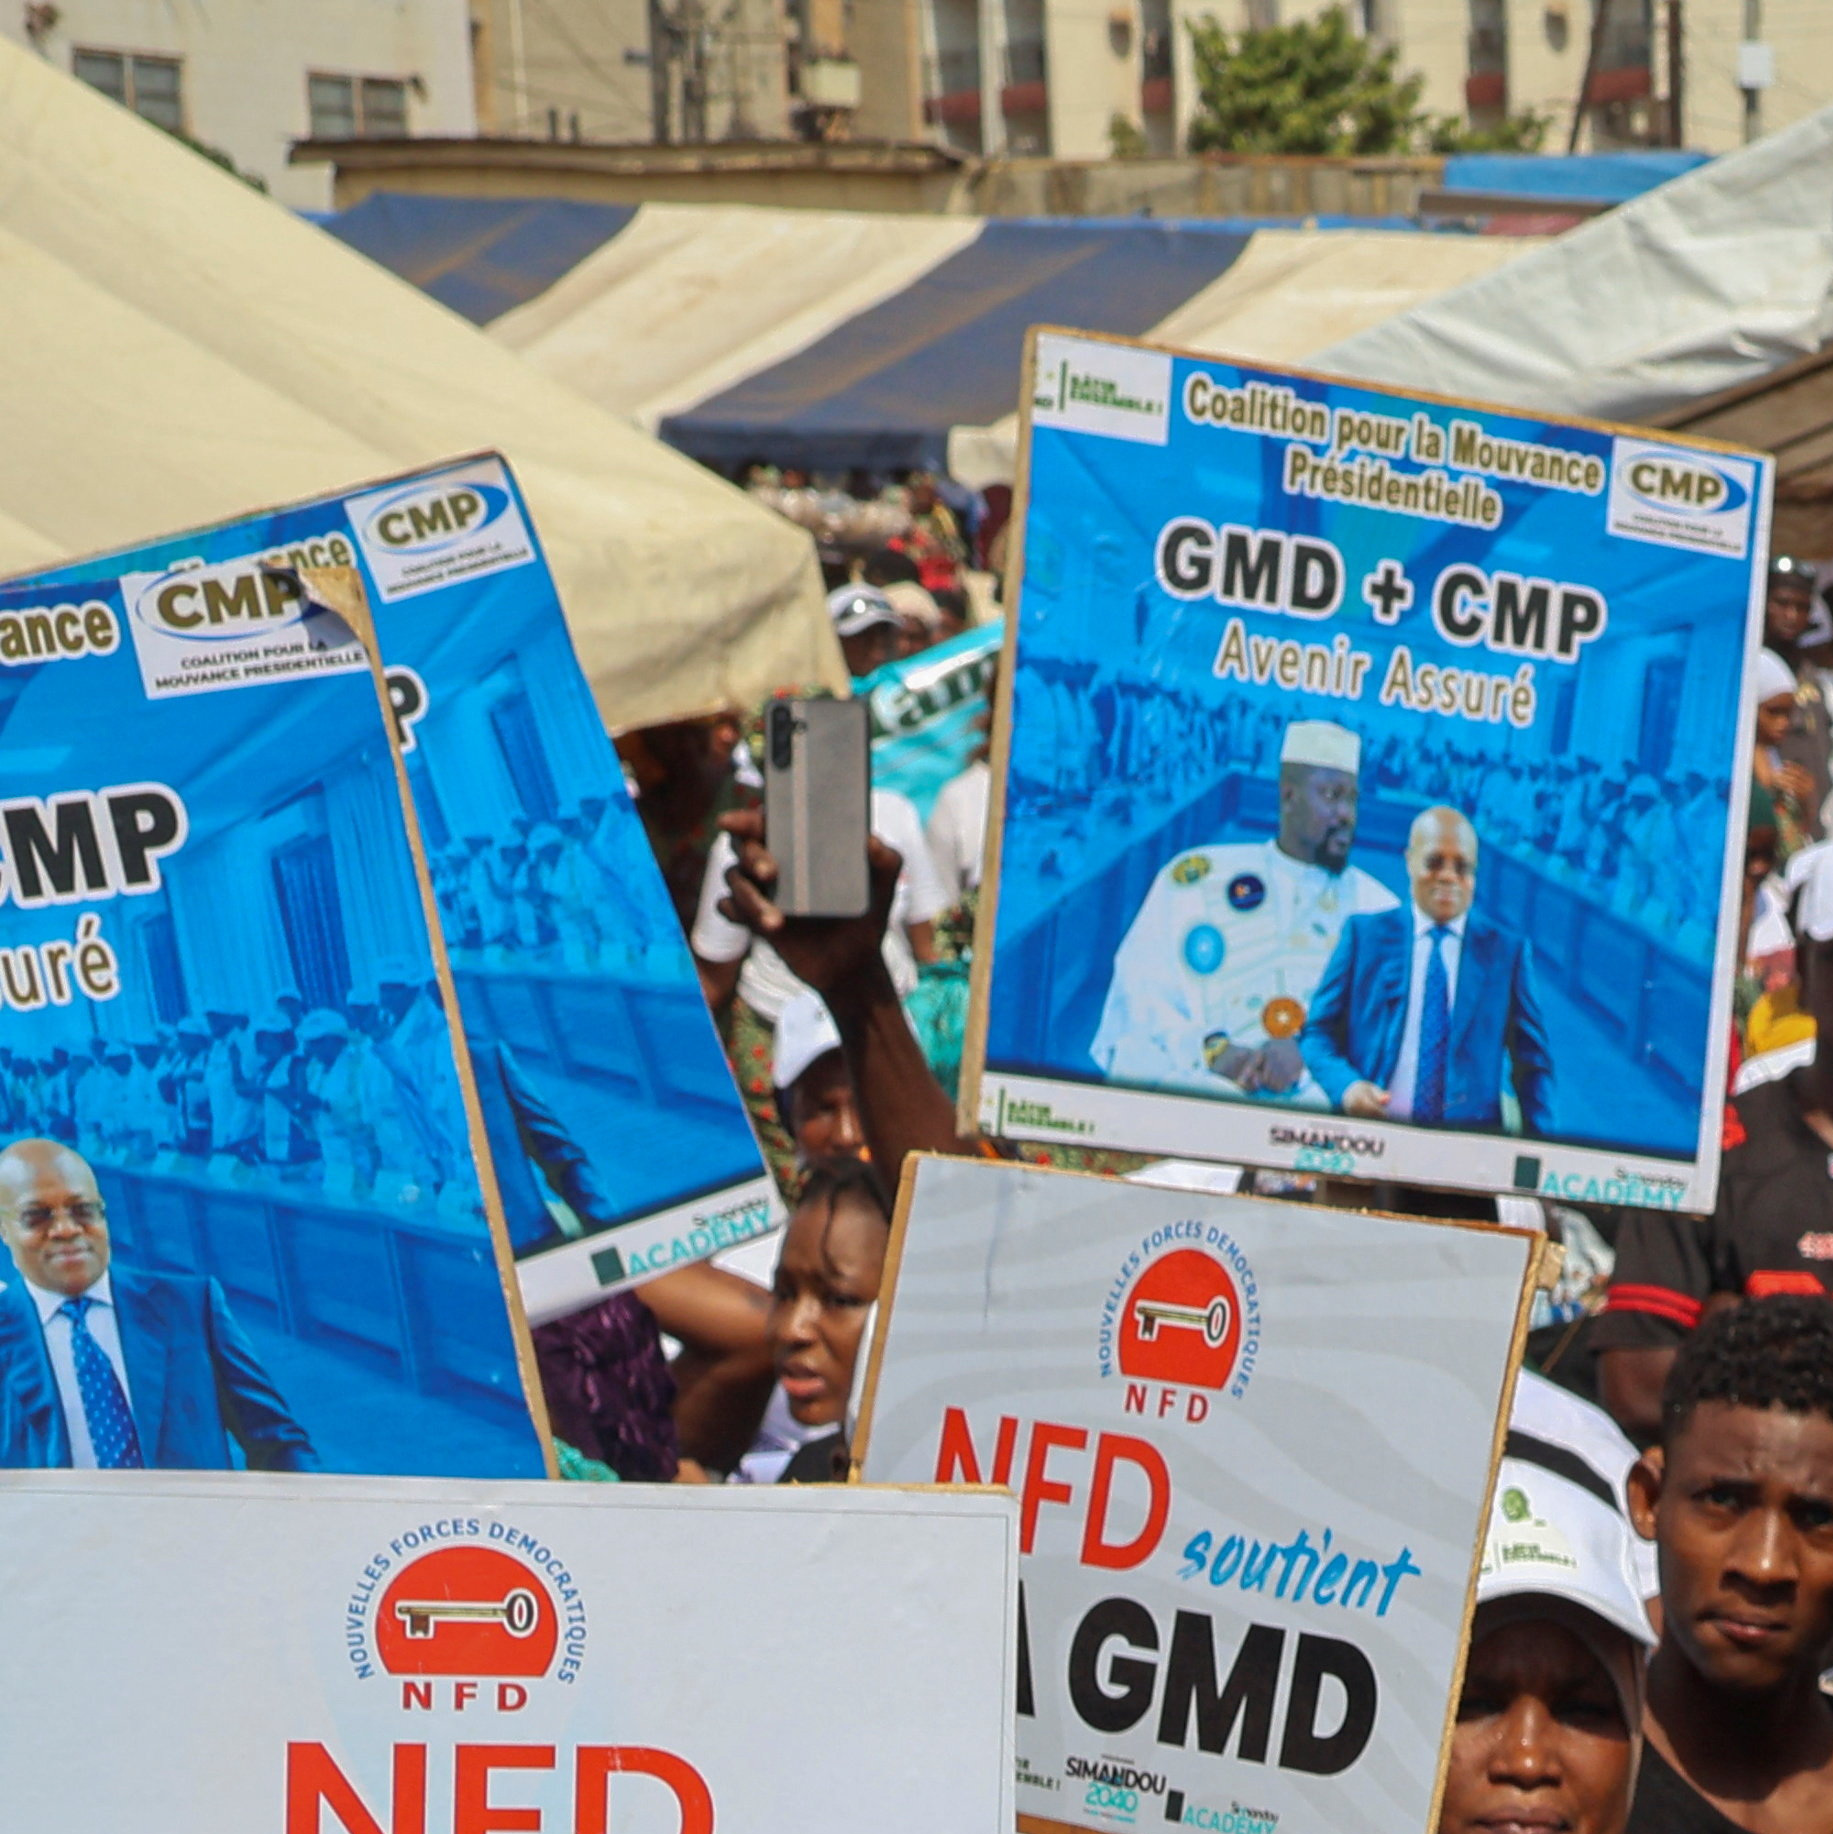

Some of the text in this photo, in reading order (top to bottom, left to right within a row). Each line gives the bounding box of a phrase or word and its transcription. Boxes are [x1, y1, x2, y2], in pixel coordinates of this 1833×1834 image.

[1190, 378, 1601, 490] Coalition pour la Mouvance
[377, 492, 479, 546] CMP
[1288, 453, 1498, 523] Présidentielle
[1630, 463, 1722, 504] CMP
[156, 573, 301, 630] CMP
[1163, 525, 1601, 657] GMD + CMP
[155, 669, 241, 690] MOUVANCE
[181, 648, 261, 669] COALITION
[262, 644, 303, 658] POUR
[1216, 623, 1534, 726] Avenir Assuré
[1099, 1219, 1261, 1399] NOUVELLES FORCES DEMOCRATIQUES
[346, 1518, 588, 1685] NOUVELLES FORCES DEMOCRATIQUES
[1182, 1529, 1423, 1617] soutient
[1067, 1596, 1381, 1776] GMD
[1066, 1756, 1167, 1796] SIMANDOU
